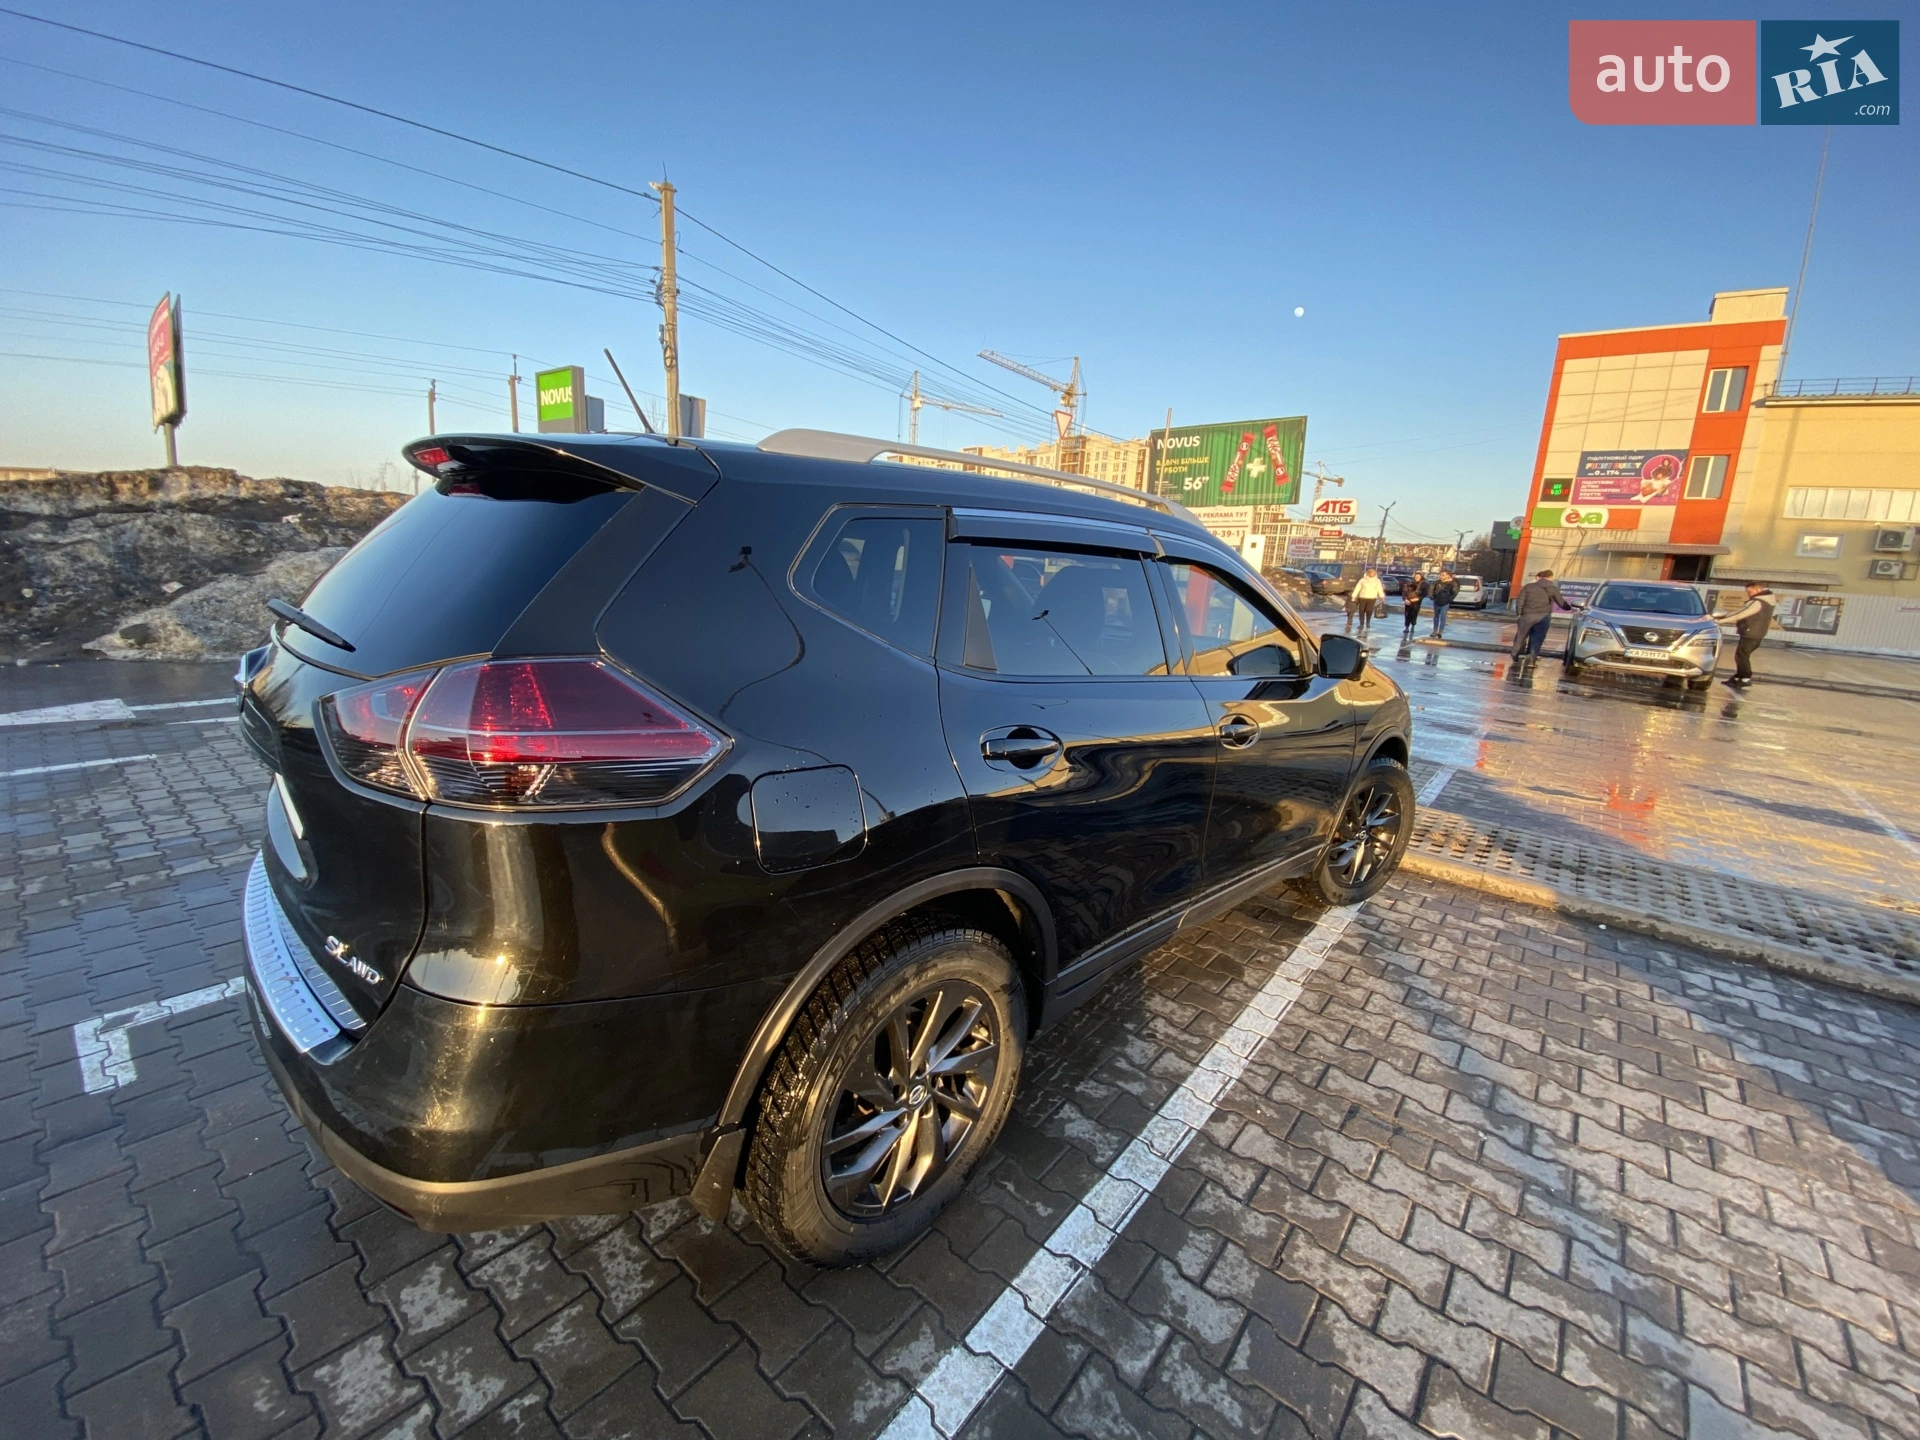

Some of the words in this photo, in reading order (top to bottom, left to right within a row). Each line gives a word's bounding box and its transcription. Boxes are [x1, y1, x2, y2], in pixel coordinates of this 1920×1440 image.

[541, 386, 572, 406] NOVUS
[1157, 436, 1201, 450] NOVUS
[1156, 466, 1188, 474] ТРБОТИ
[1315, 500, 1354, 514] АТБ
